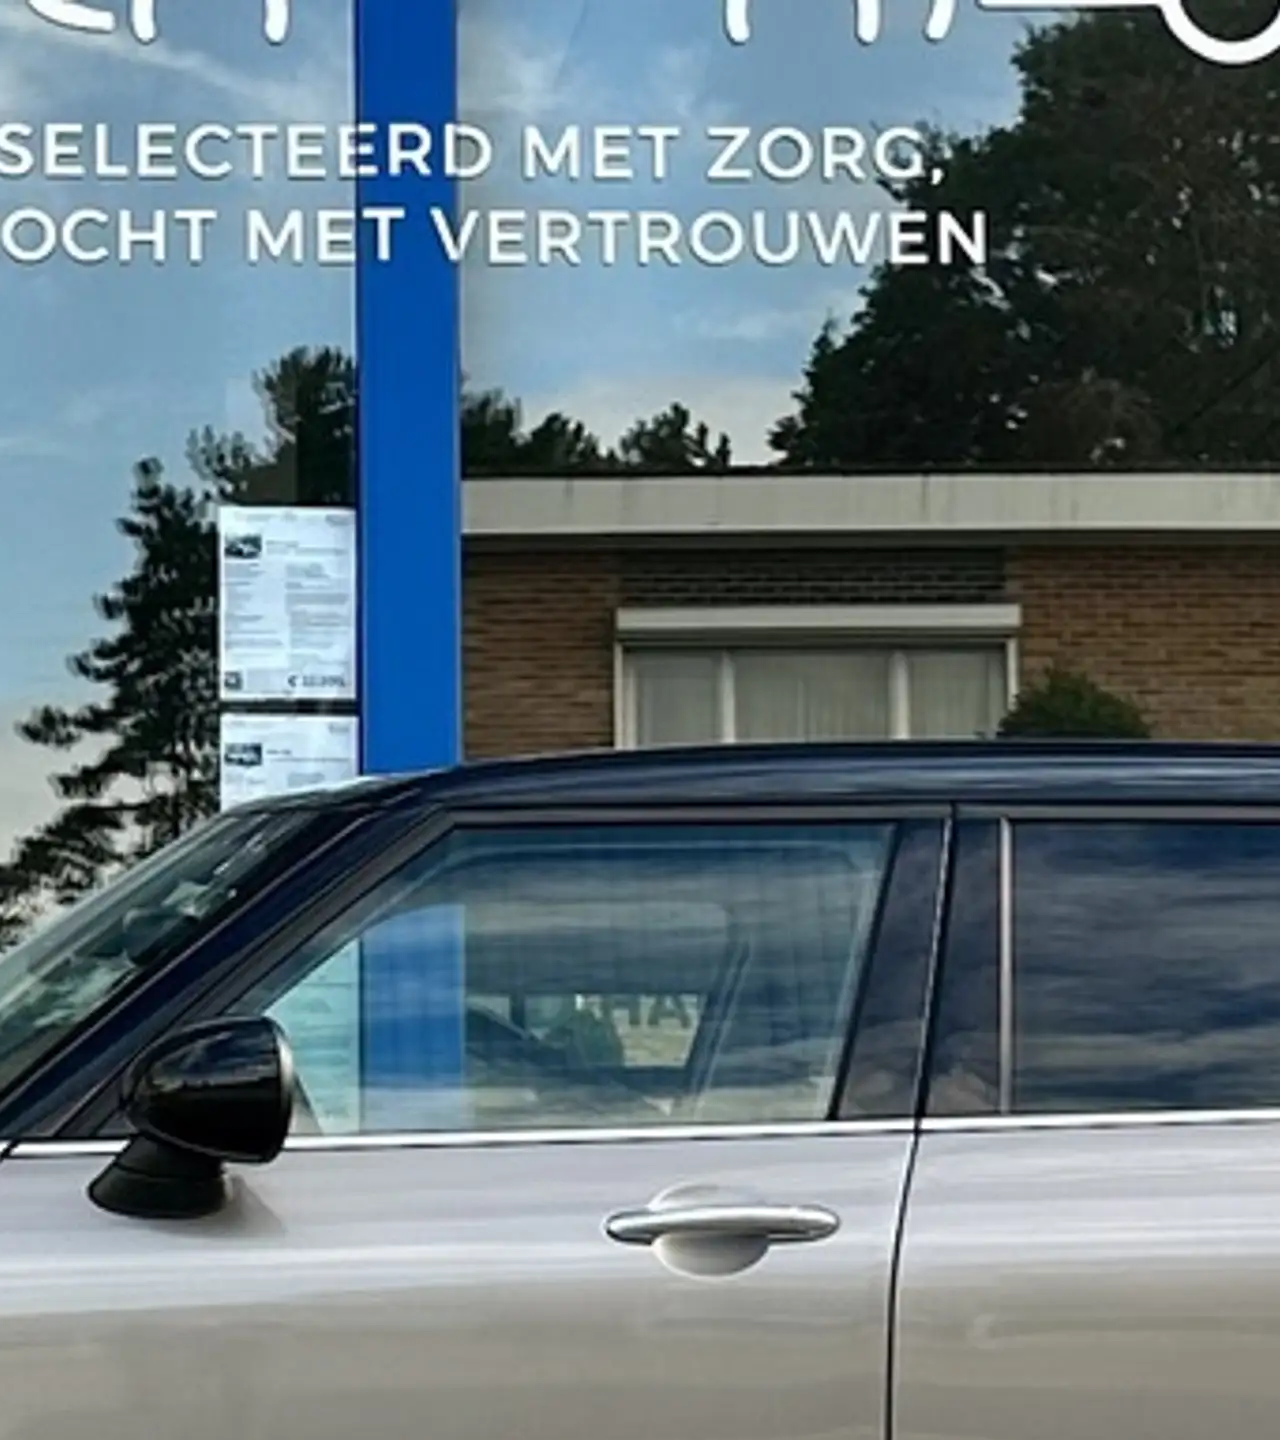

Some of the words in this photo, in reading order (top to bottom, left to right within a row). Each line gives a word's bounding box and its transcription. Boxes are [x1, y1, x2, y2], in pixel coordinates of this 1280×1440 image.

[526, 126, 680, 178] MET
[706, 127, 943, 186] ZORG,
[249, 209, 404, 262] MET
[432, 210, 990, 266] VERTROUWEN
